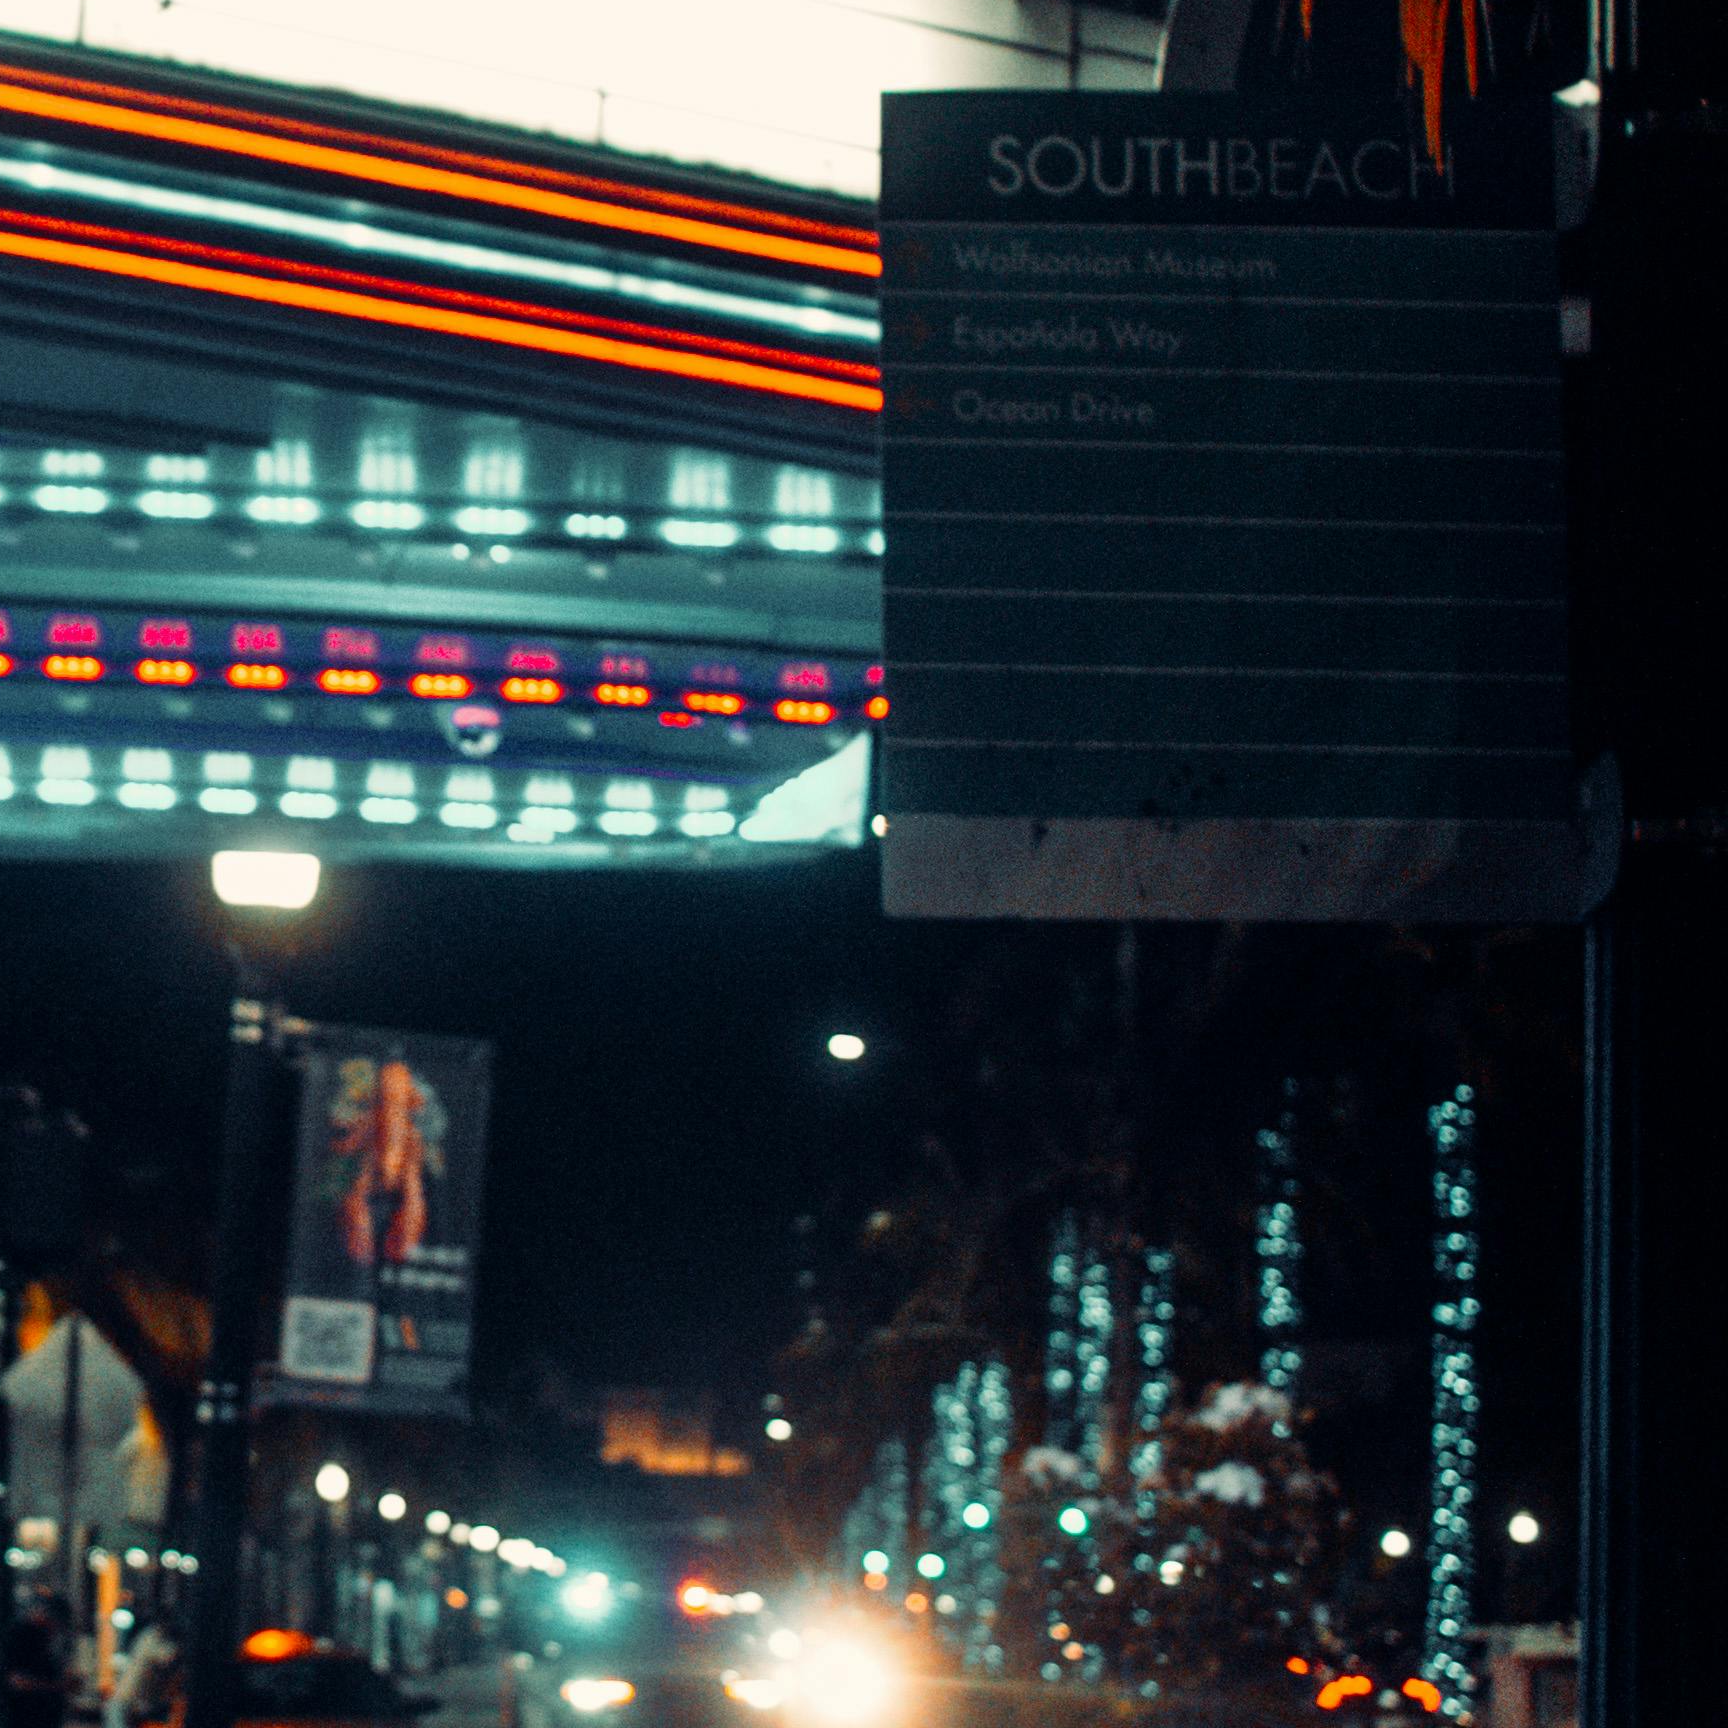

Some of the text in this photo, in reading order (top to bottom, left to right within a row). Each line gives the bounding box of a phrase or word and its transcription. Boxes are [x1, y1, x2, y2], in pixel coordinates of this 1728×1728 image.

[988, 133, 1456, 202] SOUTHBEACH
[1145, 246, 1278, 280] Museum
[1108, 315, 1182, 359] Way
[952, 387, 1155, 426] Ocean Drive
